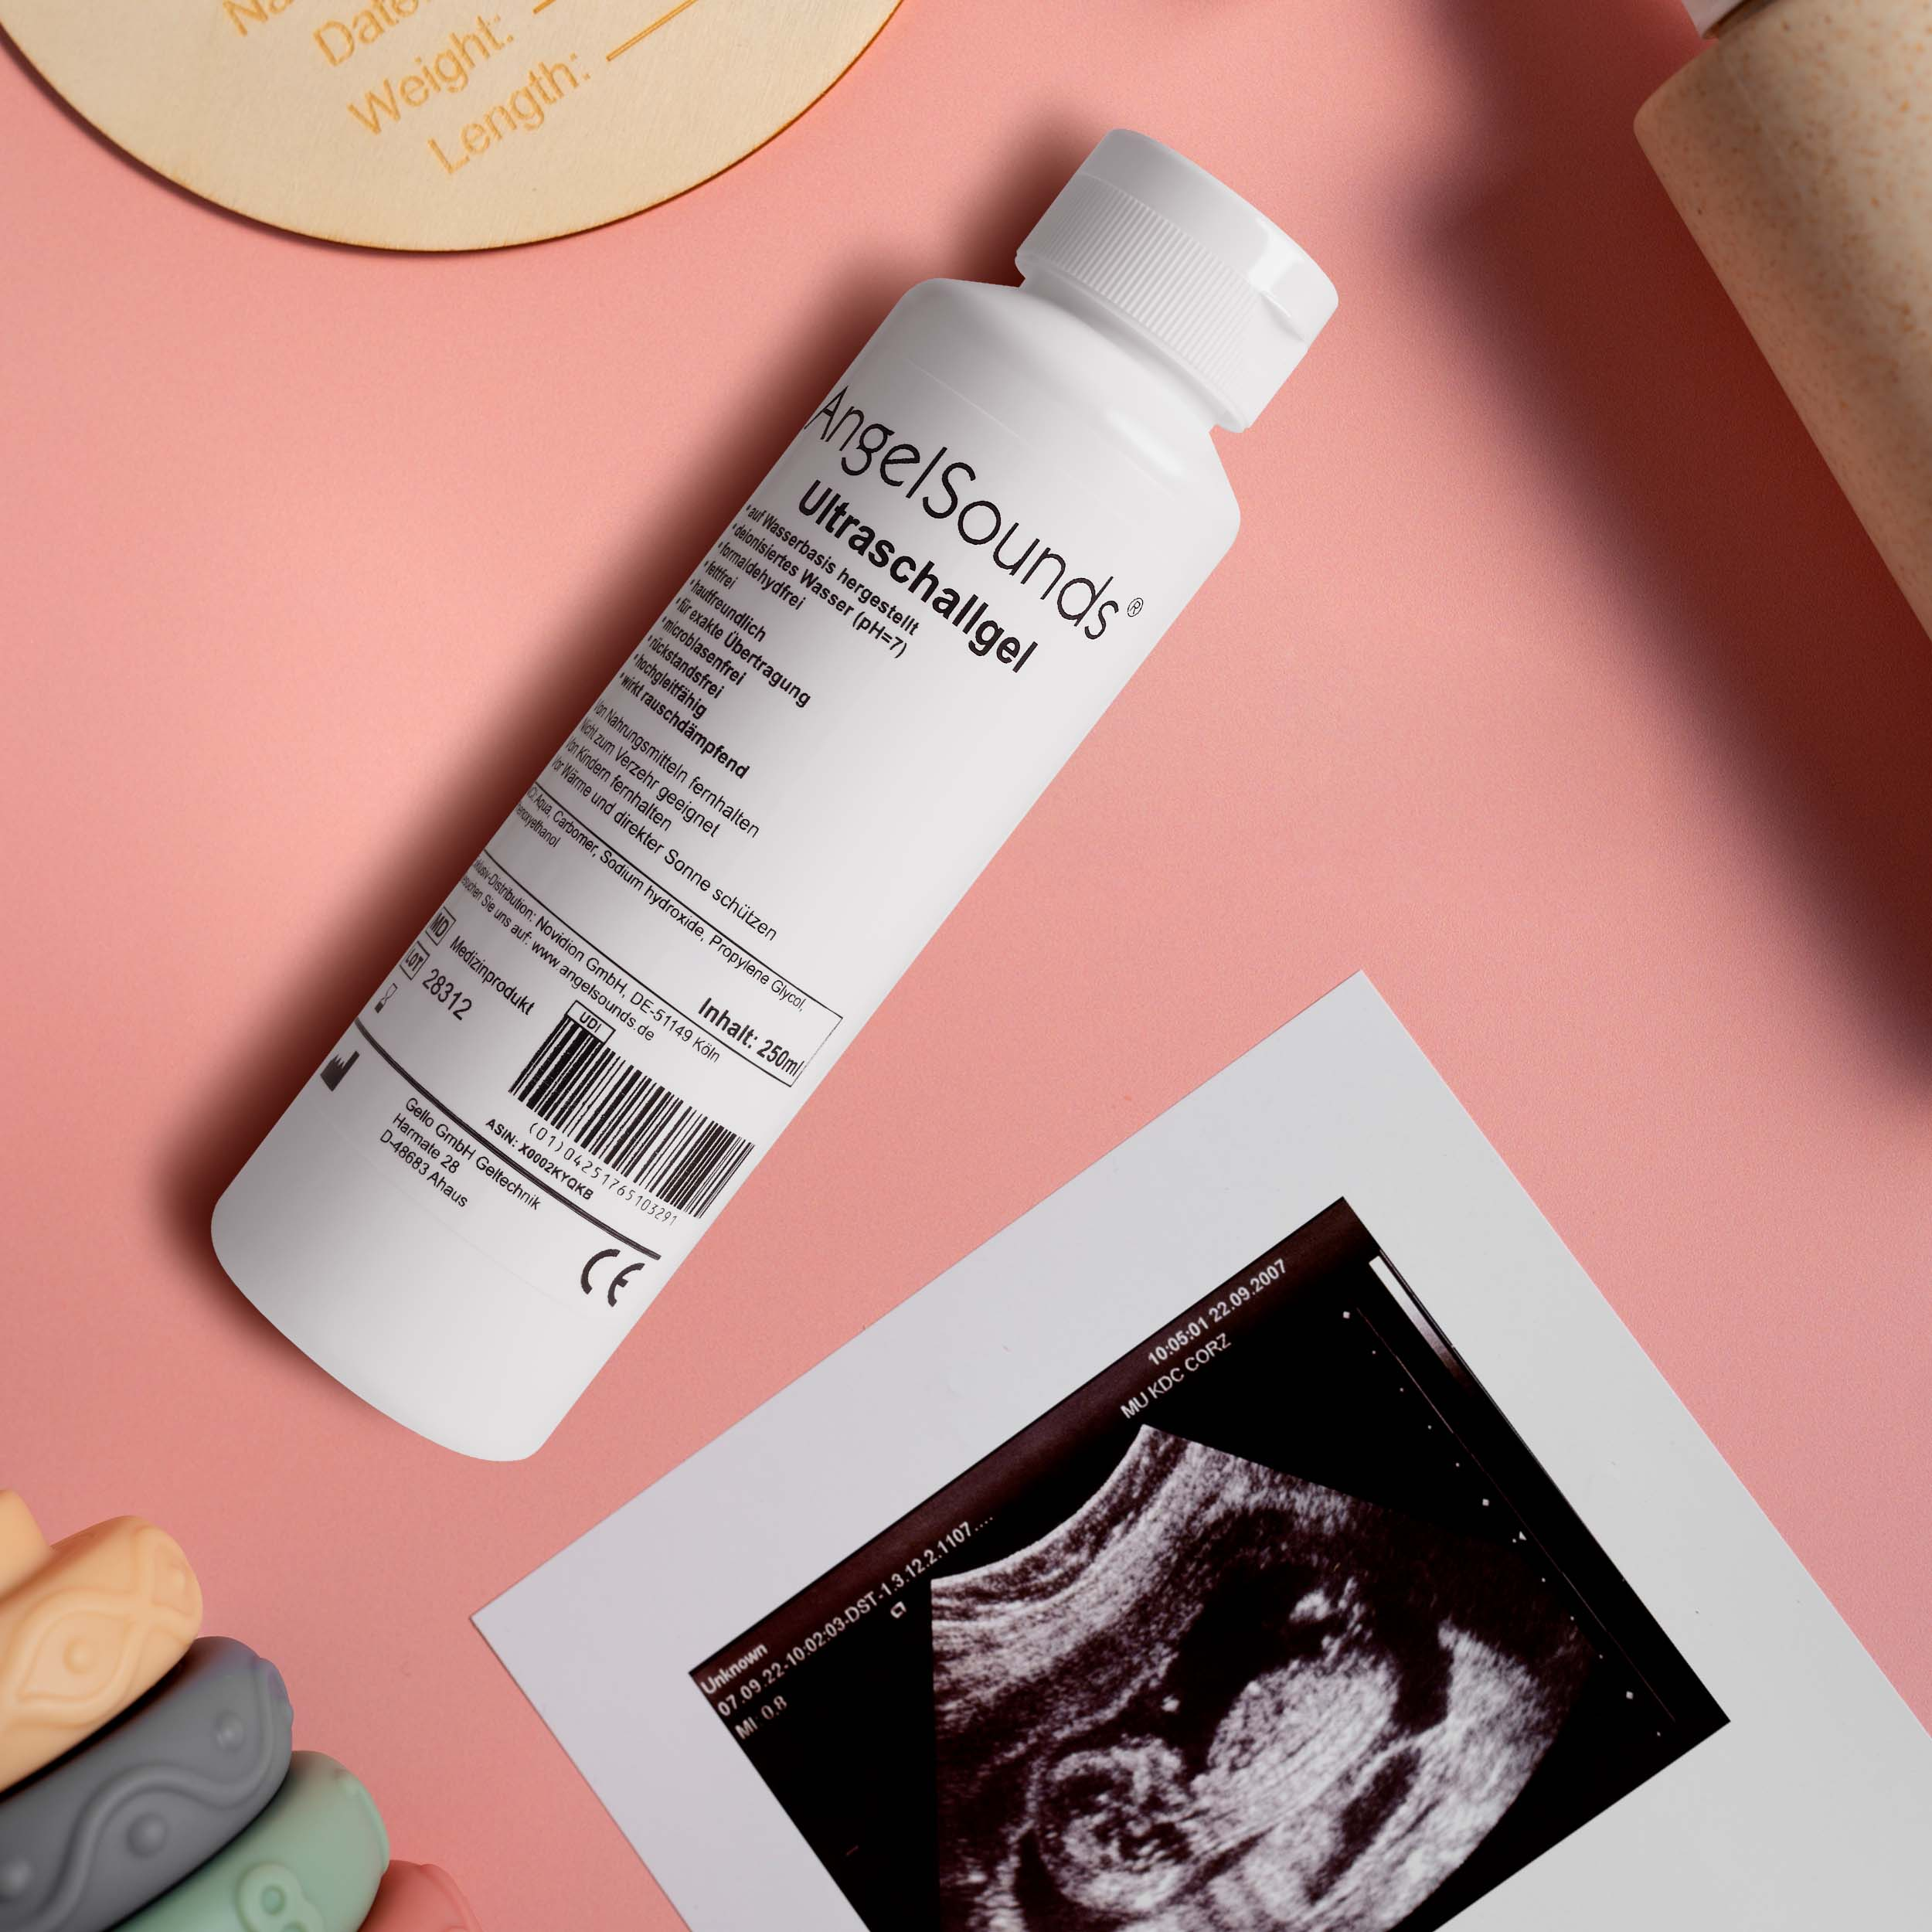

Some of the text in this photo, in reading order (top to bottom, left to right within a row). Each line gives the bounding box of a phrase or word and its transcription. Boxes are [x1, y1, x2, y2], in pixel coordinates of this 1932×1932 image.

[347, 14, 515, 135] Weight:
[427, 52, 591, 175] Length:
[690, 578, 767, 643] hautfreundlich
[704, 560, 739, 590] fettfrei
[719, 541, 807, 611] formaldehydfrei
[733, 523, 908, 659] deionisiertes Wasser (pH=7)
[747, 507, 920, 637] auf Wasserbasis hergestellt
[798, 478, 1039, 674] Ultraschallgel
[634, 653, 708, 720] hochgleitfähig
[648, 636, 726, 699] rückstandsfrei
[662, 618, 748, 686] microblasenfrei
[676, 597, 812, 709] für exakte Übertragung
[621, 674, 751, 780] wirkt rauschdämpfend
[574, 745, 612, 783] Kindern
[609, 774, 673, 832] fernhalten
[593, 733, 617, 757] zum
[614, 745, 661, 791] Verzehr
[655, 785, 722, 838] geeignet
[603, 707, 689, 784] Nahrungsmitteln
[686, 775, 761, 839] fernhalten
[560, 761, 594, 798] Wärme
[590, 791, 618, 817] und
[611, 810, 665, 854] direkter
[663, 849, 712, 893] Sonne
[710, 888, 778, 942] schützen
[430, 913, 451, 938] MD
[533, 796, 553, 819] Aqua,
[551, 811, 600, 859] Carbomer,
[598, 849, 646, 893] Sodium
[643, 883, 706, 943] hydroxide,
[706, 930, 770, 985] Propylene
[770, 977, 806, 1012] Glycol,
[405, 947, 429, 971] LOT
[421, 968, 473, 1021] 28312
[449, 934, 536, 1016] Medizinprodukt
[480, 893, 496, 913] Sie
[492, 907, 512, 928] uns
[509, 923, 532, 946] auf:
[531, 940, 655, 1042] www.angelsounds.de
[534, 914, 586, 964] Novidion
[583, 956, 628, 1002] GmbH,
[627, 987, 695, 1044] DE-51149
[692, 1032, 721, 1063] Köln
[578, 1011, 603, 1035] UDI
[697, 996, 806, 1079] Inhalt: 250ml
[379, 1128, 468, 1208] D-48683 Ahaus
[392, 1112, 461, 1175] Harmate 28
[405, 1097, 542, 1211] Gello GmbH Geltechnik
[485, 1118, 594, 1202] ASIN: X0002KYQKB
[1148, 1257, 1286, 1366] 10:05:01 22.09.2007
[1120, 1332, 1232, 1419] MU KDC CORZ
[699, 1644, 768, 1695] Unknown
[760, 1696, 787, 1719] 0.8
